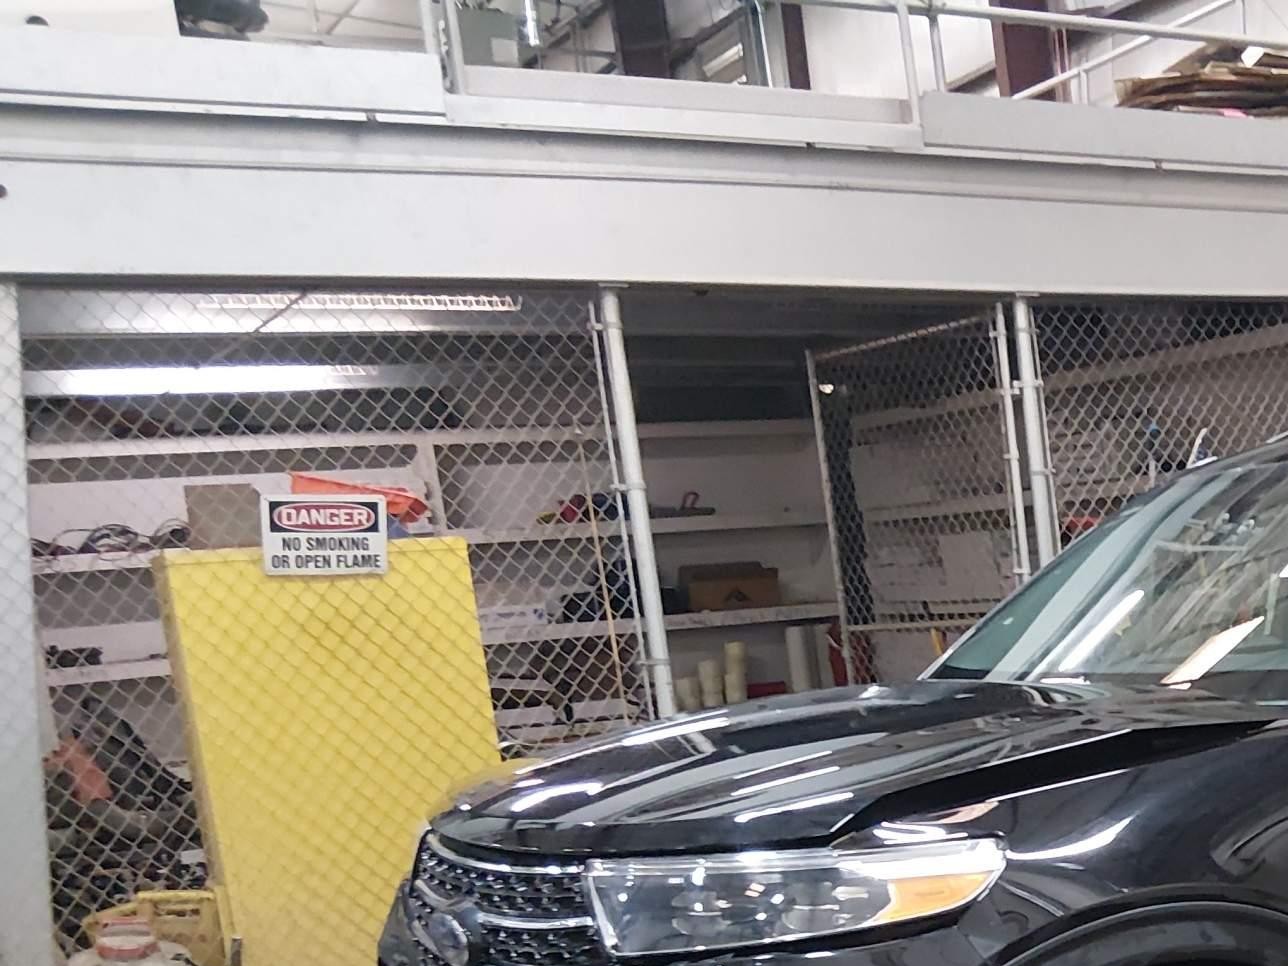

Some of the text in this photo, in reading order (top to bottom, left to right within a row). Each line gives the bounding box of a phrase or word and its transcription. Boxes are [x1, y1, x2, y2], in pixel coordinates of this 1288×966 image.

[281, 509, 368, 526] DANGER
[282, 537, 369, 551] NO SMOKING
[272, 554, 381, 568] OR OPEN FLAME
